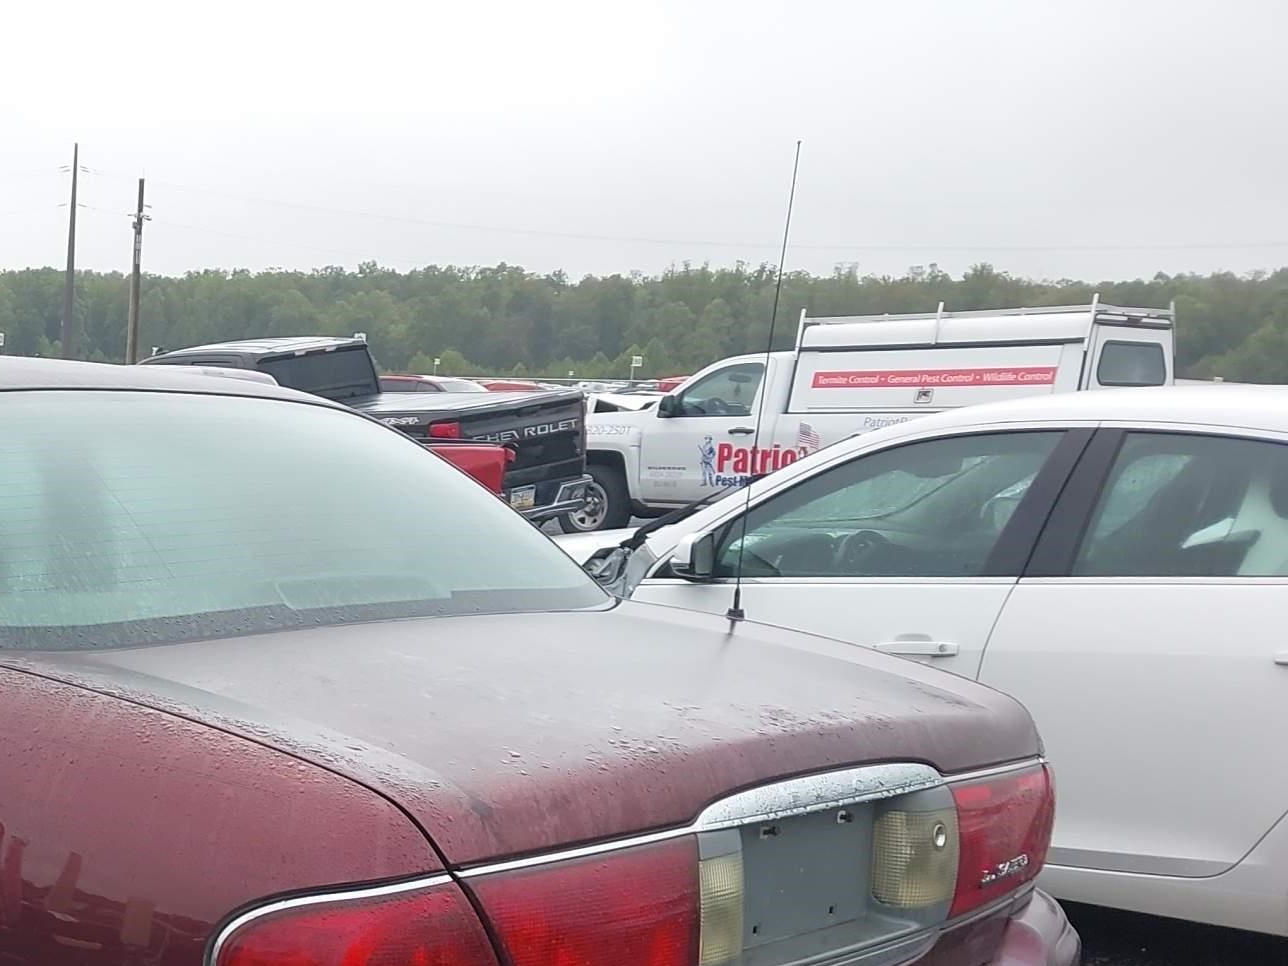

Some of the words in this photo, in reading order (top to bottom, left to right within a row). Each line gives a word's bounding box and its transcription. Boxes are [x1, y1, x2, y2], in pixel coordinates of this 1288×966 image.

[818, 376, 848, 385] Termite
[849, 376, 880, 384] Control
[887, 374, 921, 384] General
[921, 374, 939, 383] Pest
[940, 373, 974, 382] Control
[983, 371, 1016, 382] Wildlife
[1017, 371, 1054, 381] Control
[717, 443, 809, 474] Patrio
